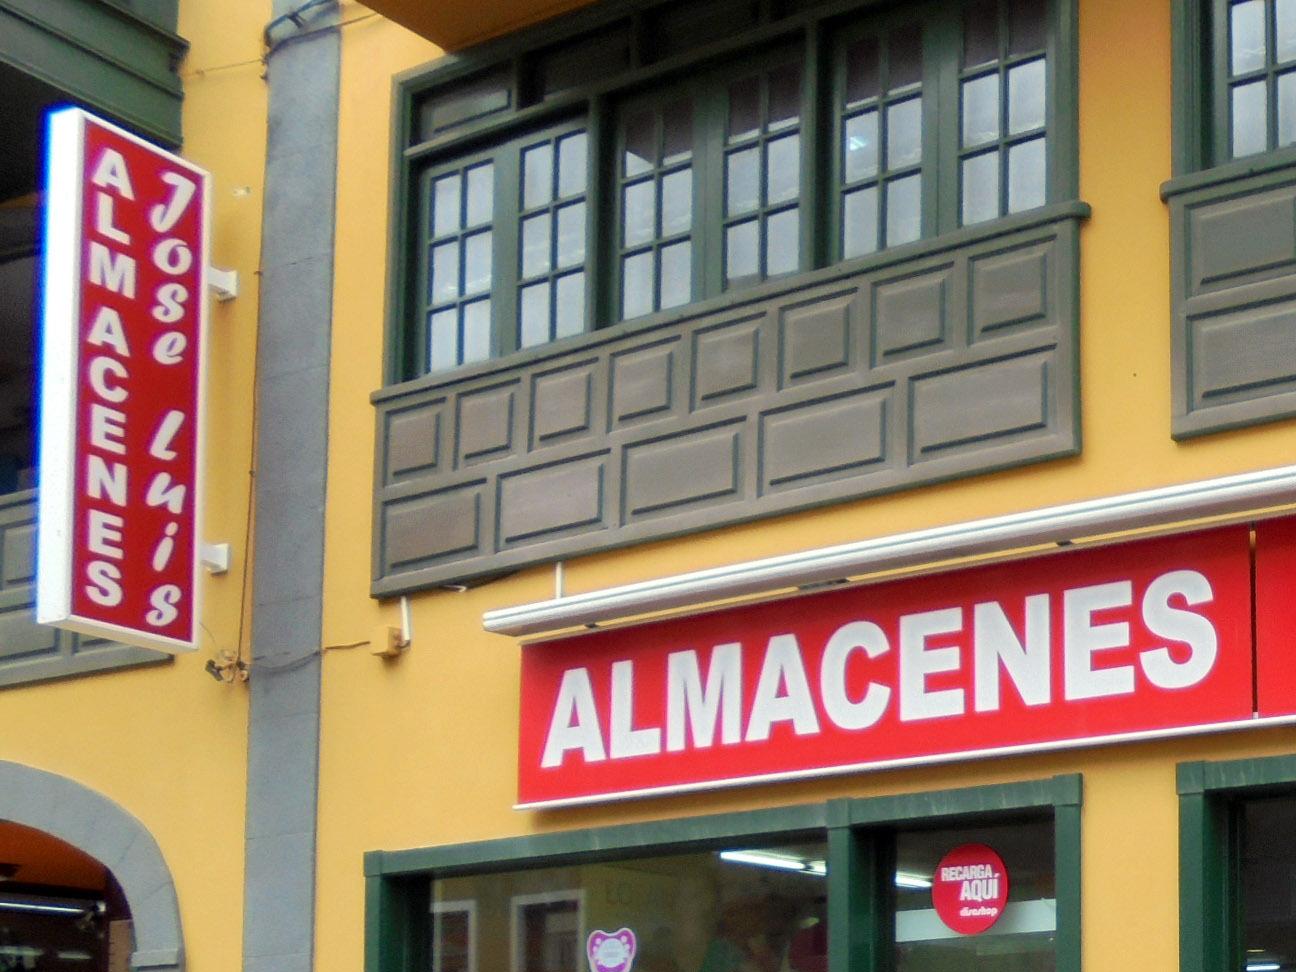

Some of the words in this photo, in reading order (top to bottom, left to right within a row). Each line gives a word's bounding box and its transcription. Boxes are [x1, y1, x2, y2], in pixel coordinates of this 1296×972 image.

[86, 148, 135, 607] ALMACENES
[541, 570, 1219, 768] ALMACENES
[941, 864, 993, 881] RECARGA
[960, 873, 1000, 902] AQUÍ
